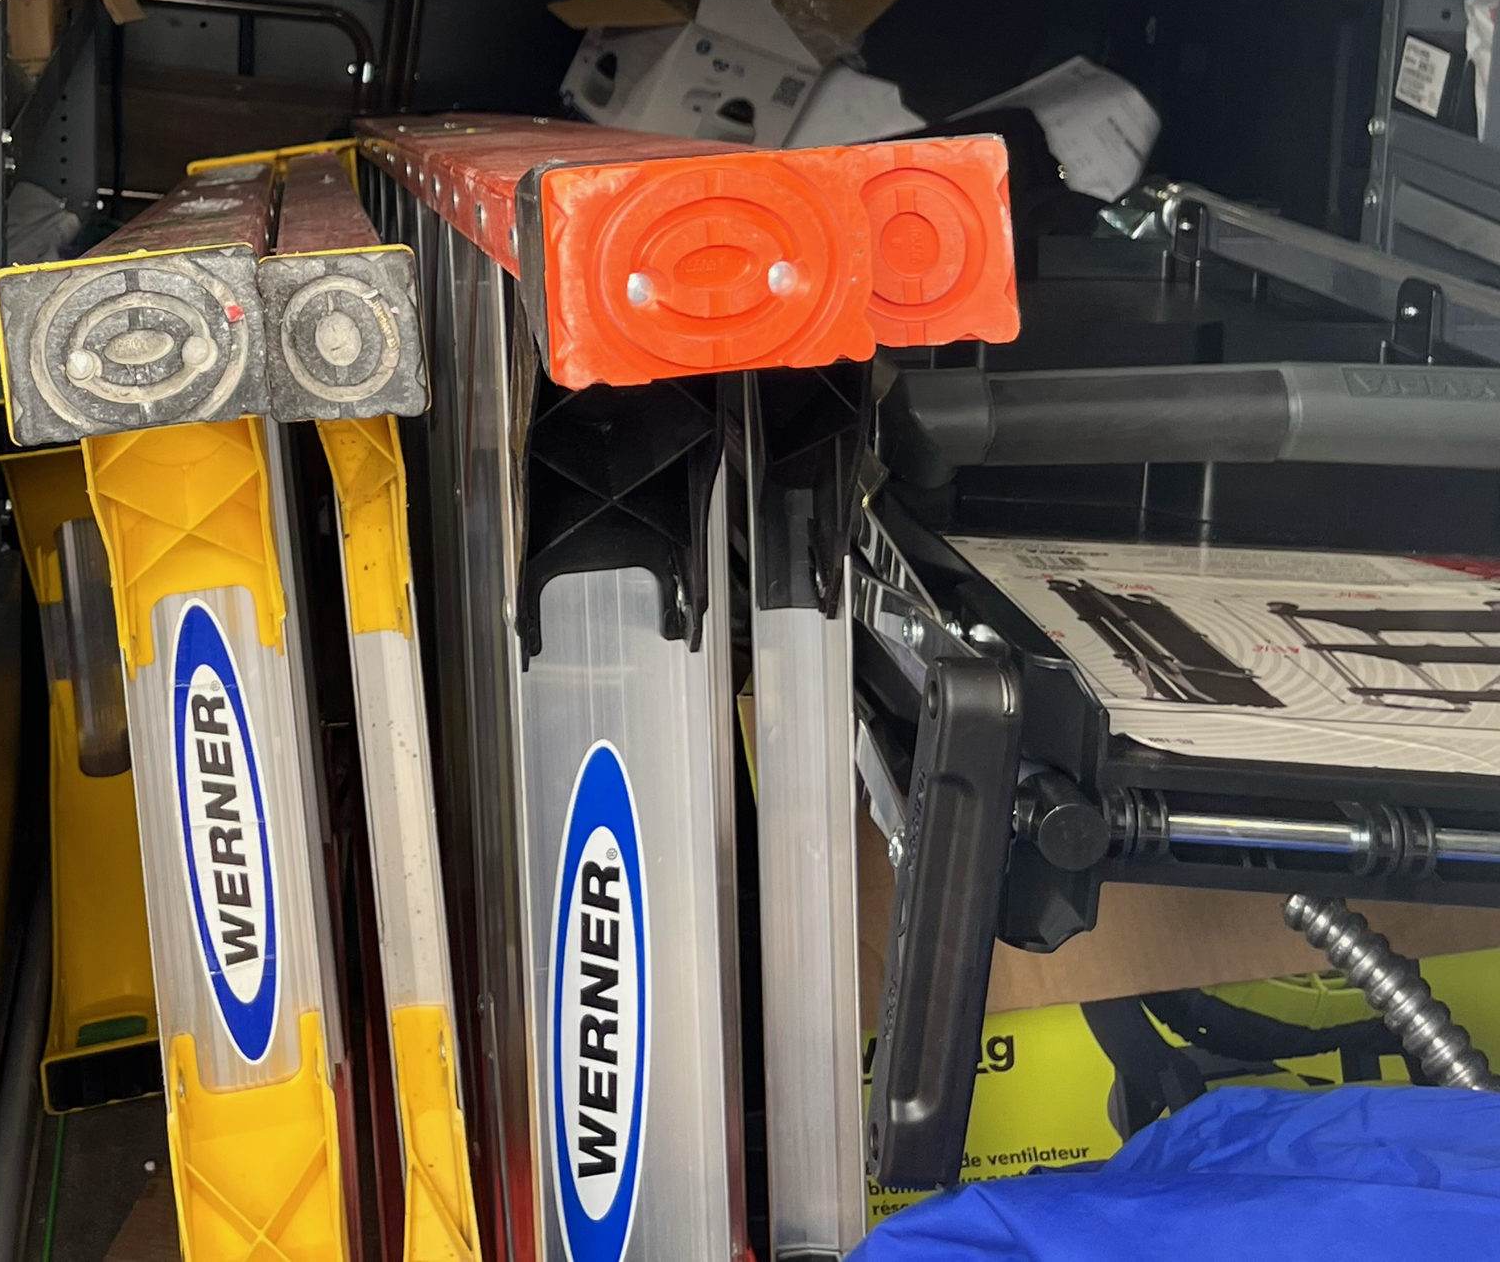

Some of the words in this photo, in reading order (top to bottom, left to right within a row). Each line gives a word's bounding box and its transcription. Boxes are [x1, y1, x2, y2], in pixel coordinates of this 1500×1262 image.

[191, 693, 260, 967] WERNER
[577, 858, 621, 1180] WERNER
[987, 1145, 1090, 1166] ventilateur
